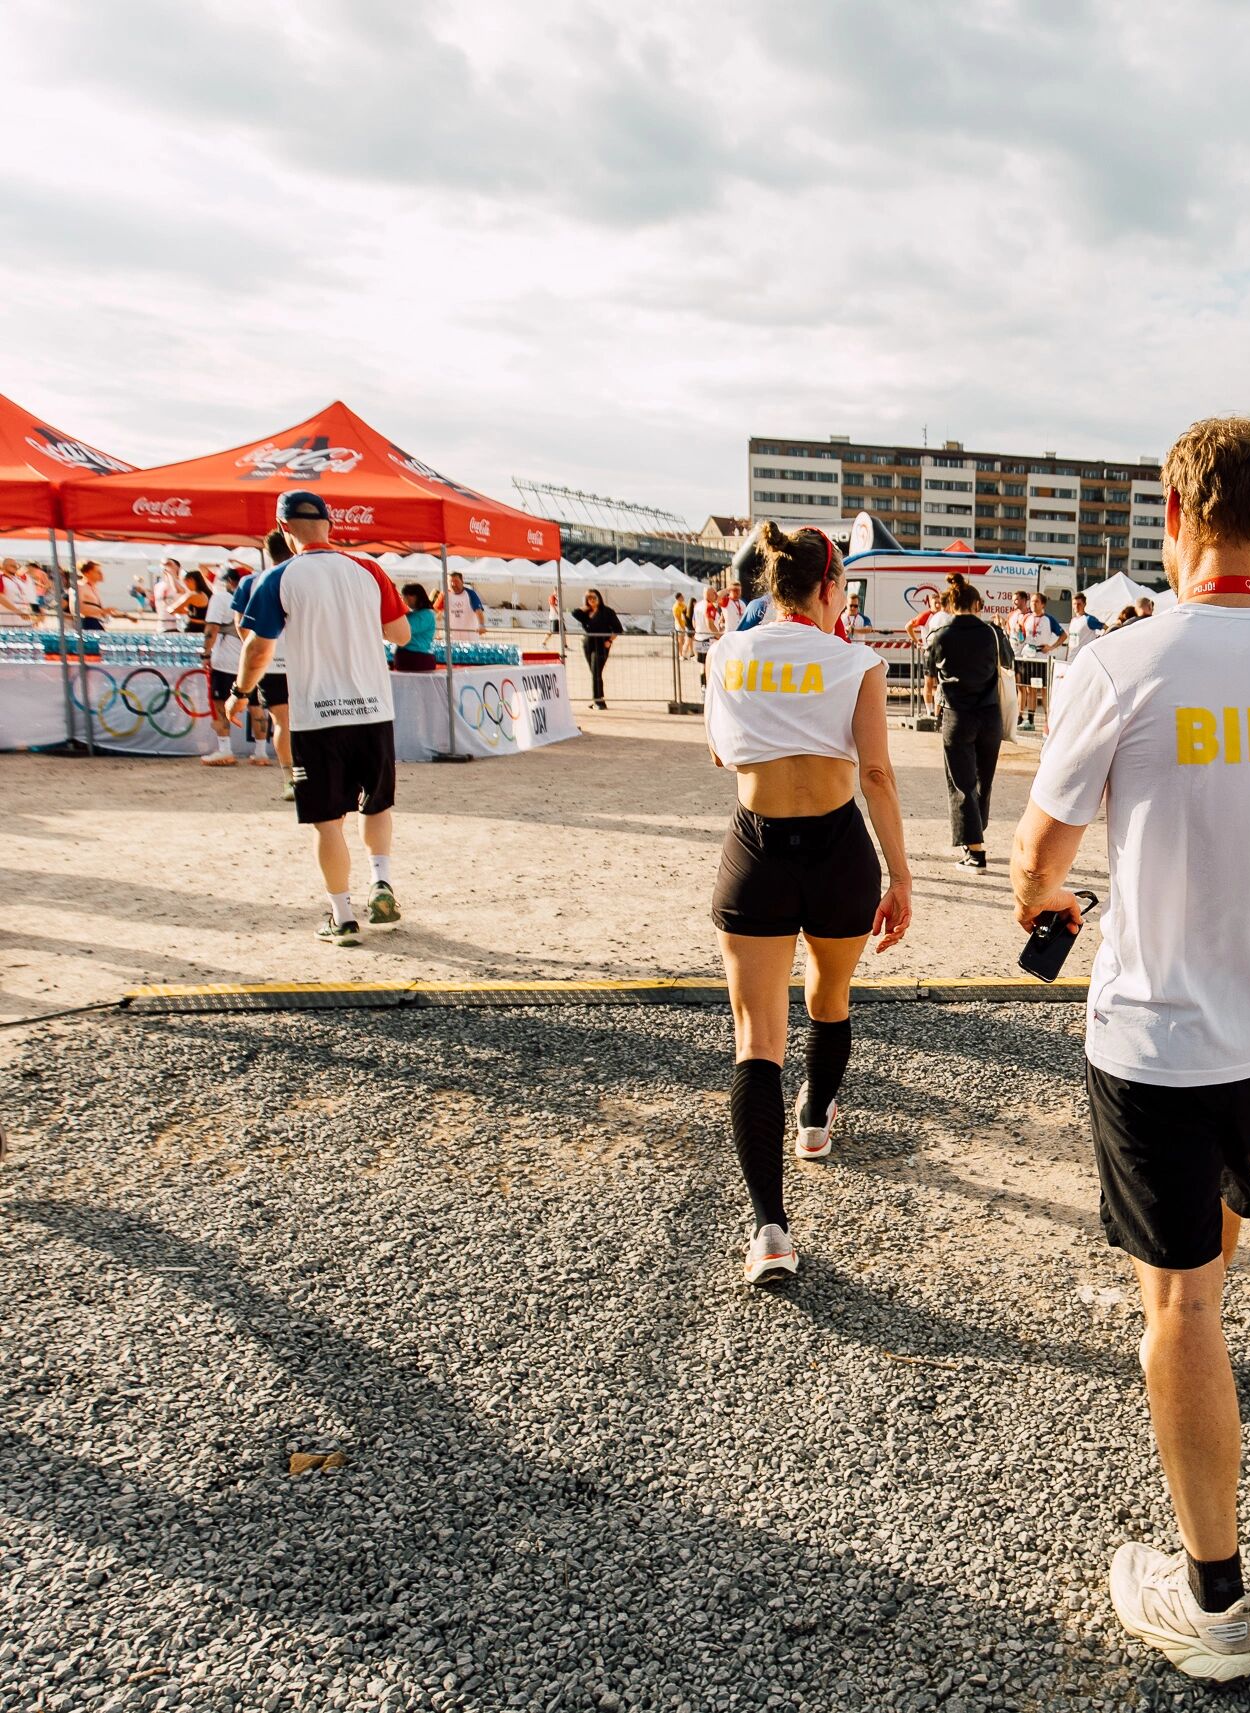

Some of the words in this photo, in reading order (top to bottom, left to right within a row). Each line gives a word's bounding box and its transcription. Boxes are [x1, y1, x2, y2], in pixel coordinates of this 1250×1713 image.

[326, 503, 374, 524] oca-Cola
[997, 591, 1012, 600] 736
[522, 672, 560, 703] OLYMPIC
[725, 658, 824, 694] BILLA
[531, 706, 548, 735] DAY
